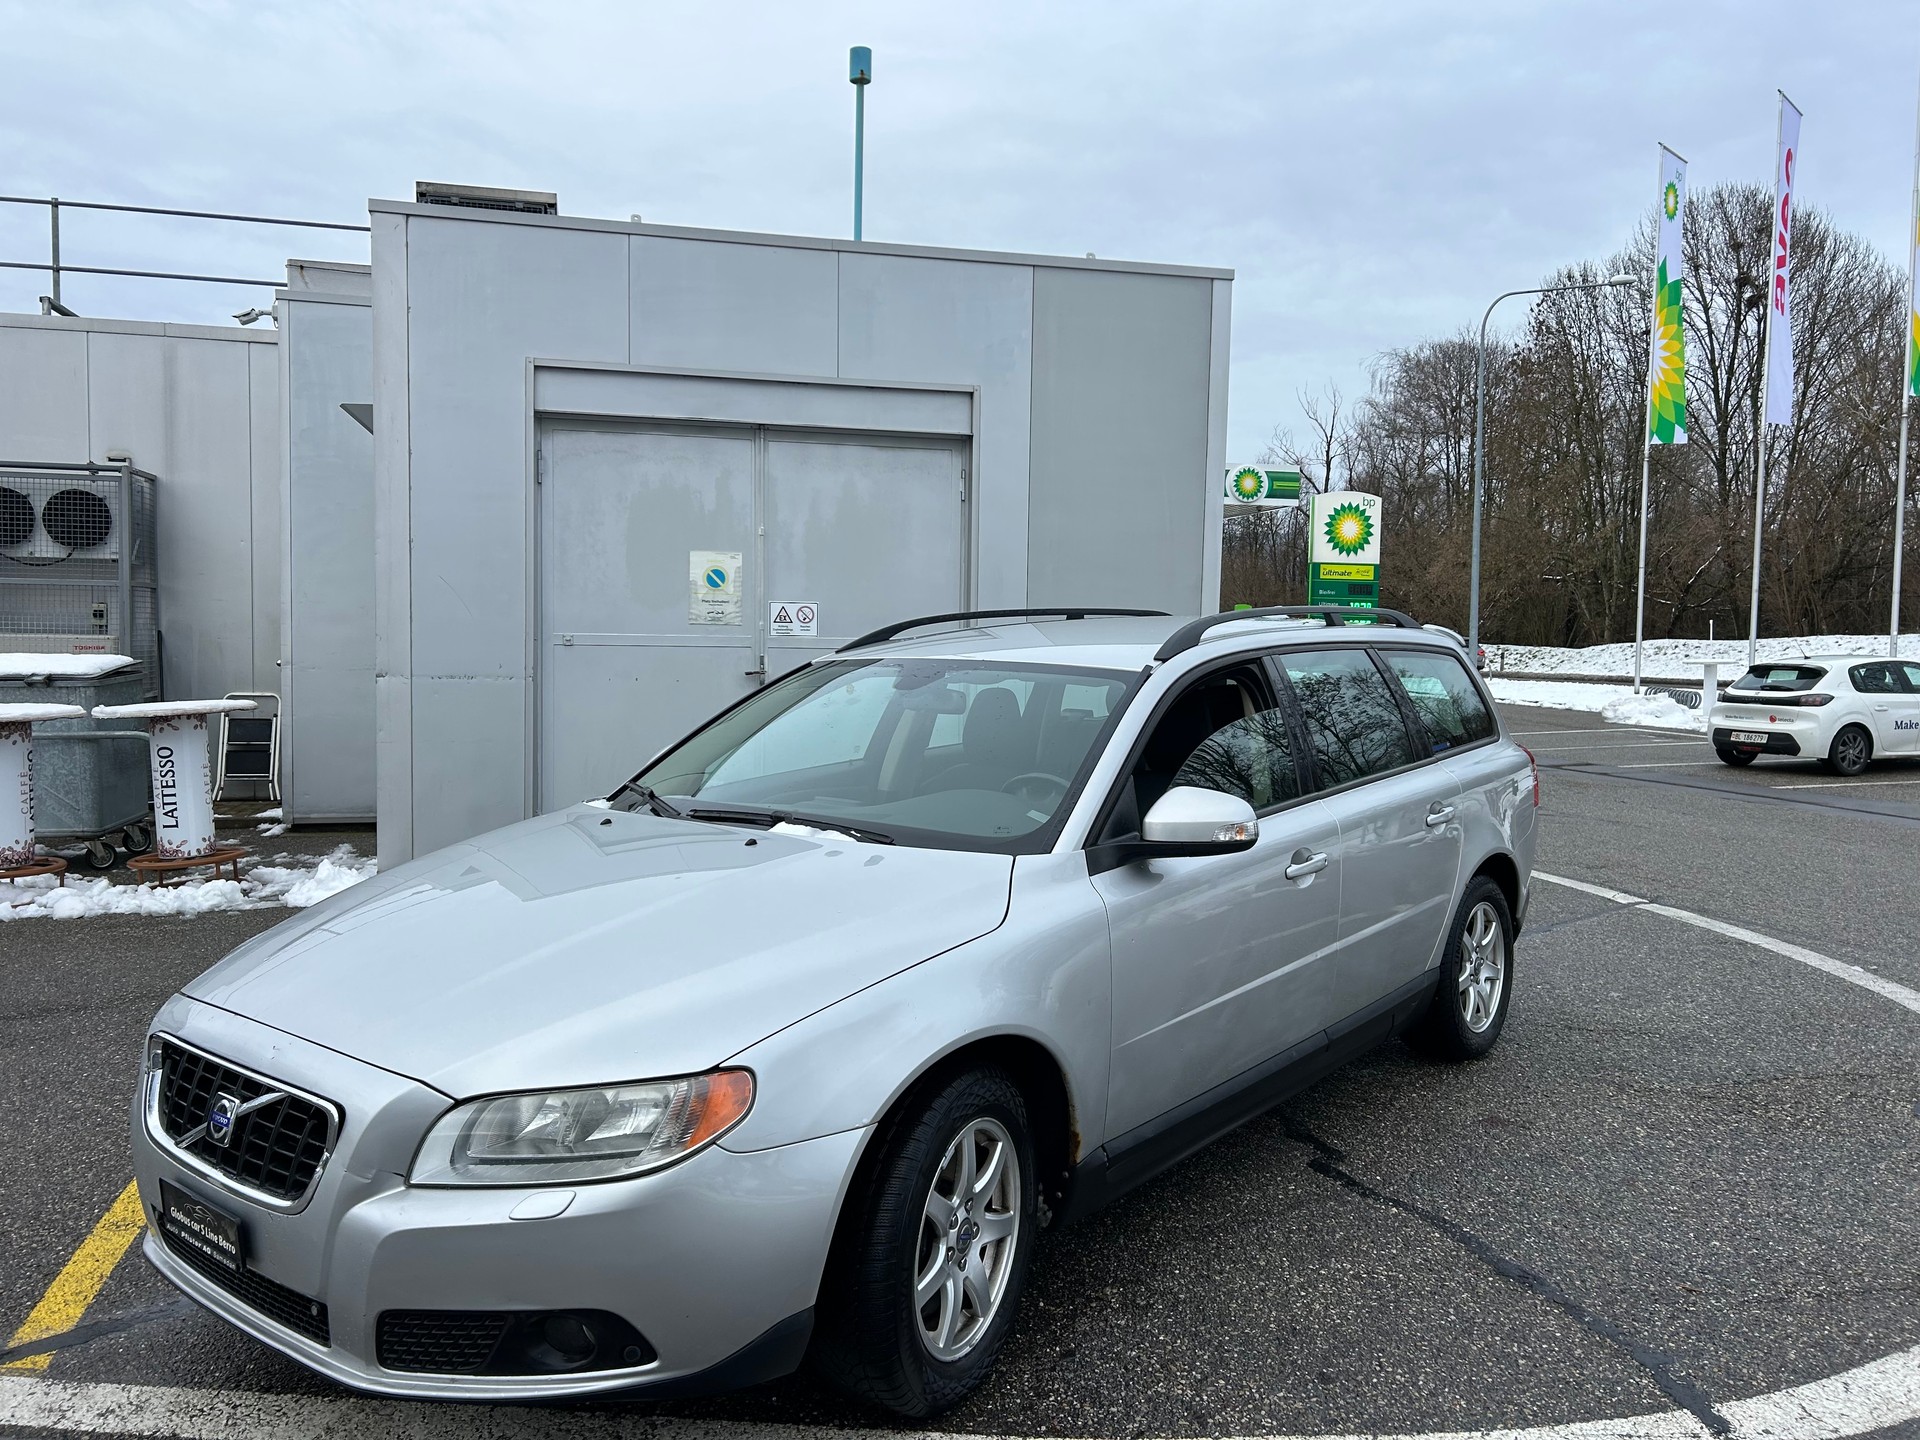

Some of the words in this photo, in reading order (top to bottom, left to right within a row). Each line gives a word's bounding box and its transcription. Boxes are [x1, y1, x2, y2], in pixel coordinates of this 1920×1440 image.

[1362, 496, 1376, 509] bp
[1894, 719, 1920, 730] Make
[18, 770, 29, 815] CAFFÈ
[156, 746, 179, 829] LATTESSO
[166, 1223, 179, 1234] Auto
[202, 1245, 211, 1255] AG
[170, 1206, 191, 1227] Globus
[190, 1220, 201, 1232] car
[200, 1224, 205, 1235] S
[205, 1227, 218, 1244] Line
[218, 1235, 236, 1254] Berro
